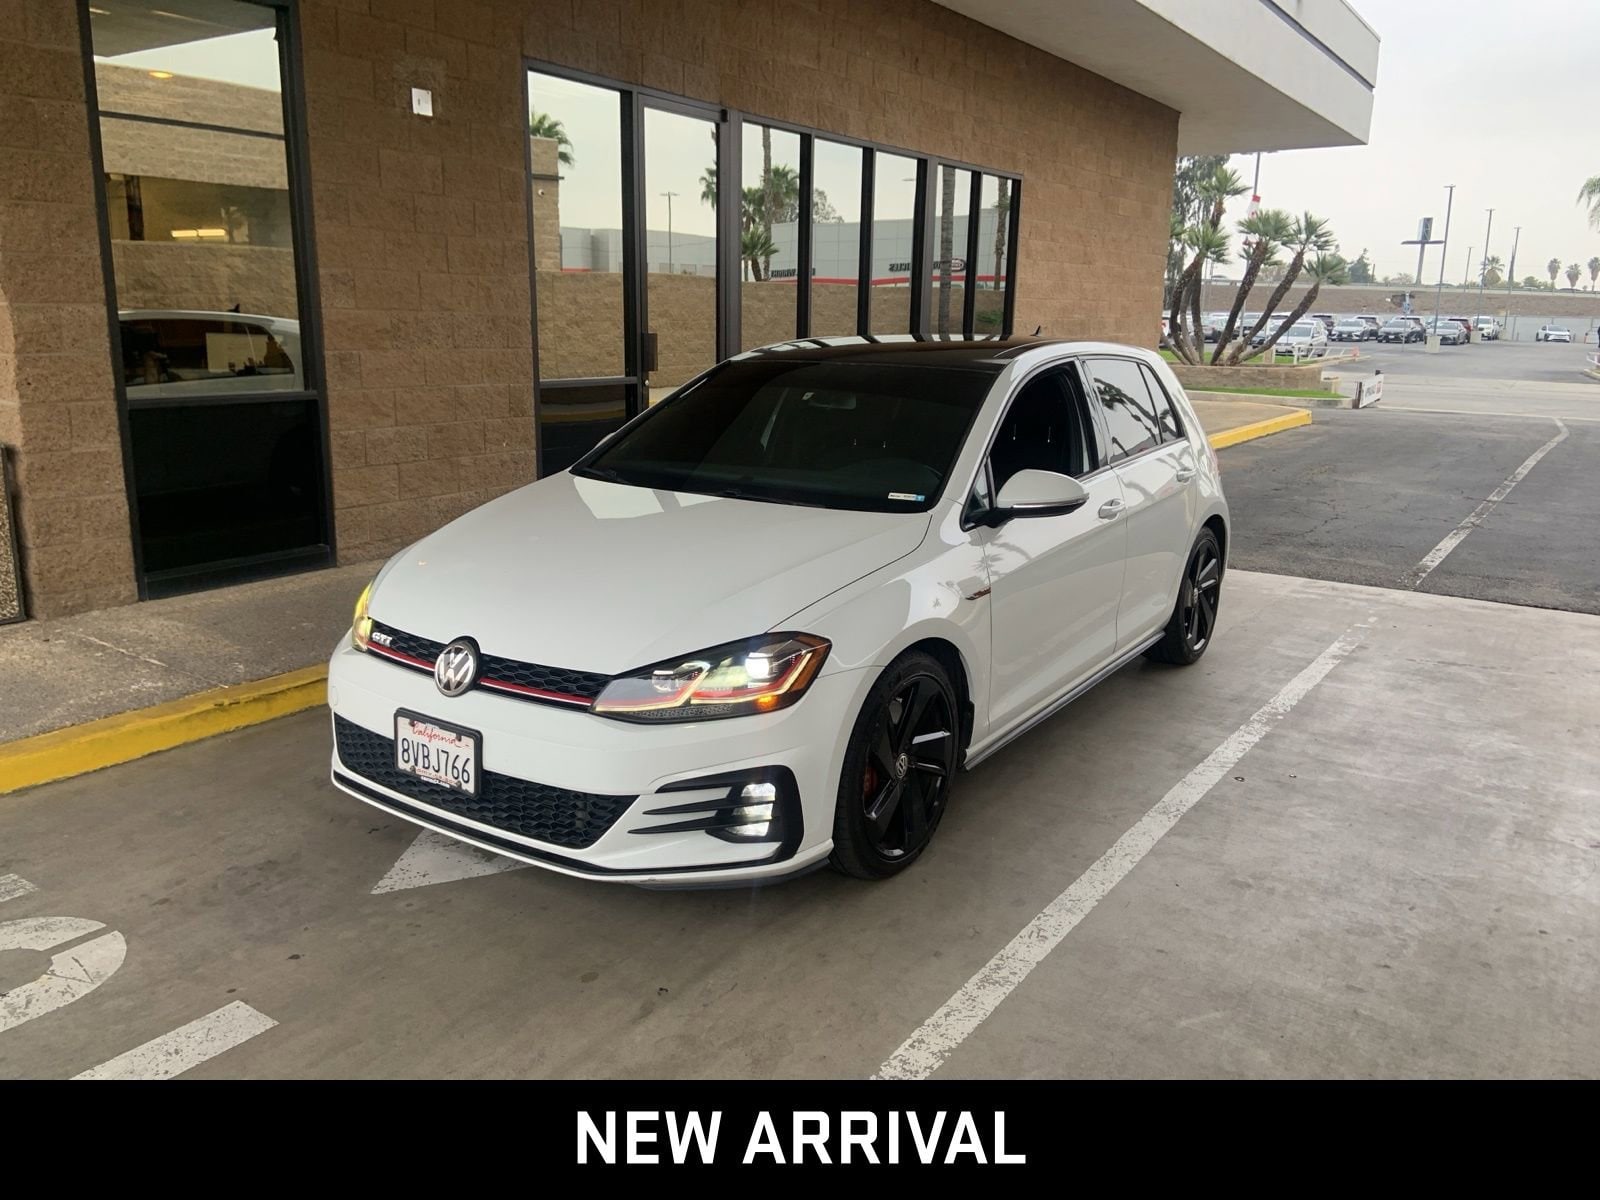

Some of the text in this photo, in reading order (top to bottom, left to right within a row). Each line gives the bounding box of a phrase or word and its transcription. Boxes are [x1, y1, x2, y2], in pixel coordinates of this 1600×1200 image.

[372, 632, 392, 647] GTI
[412, 720, 464, 747] California
[401, 738, 470, 784] 8VBJ766
